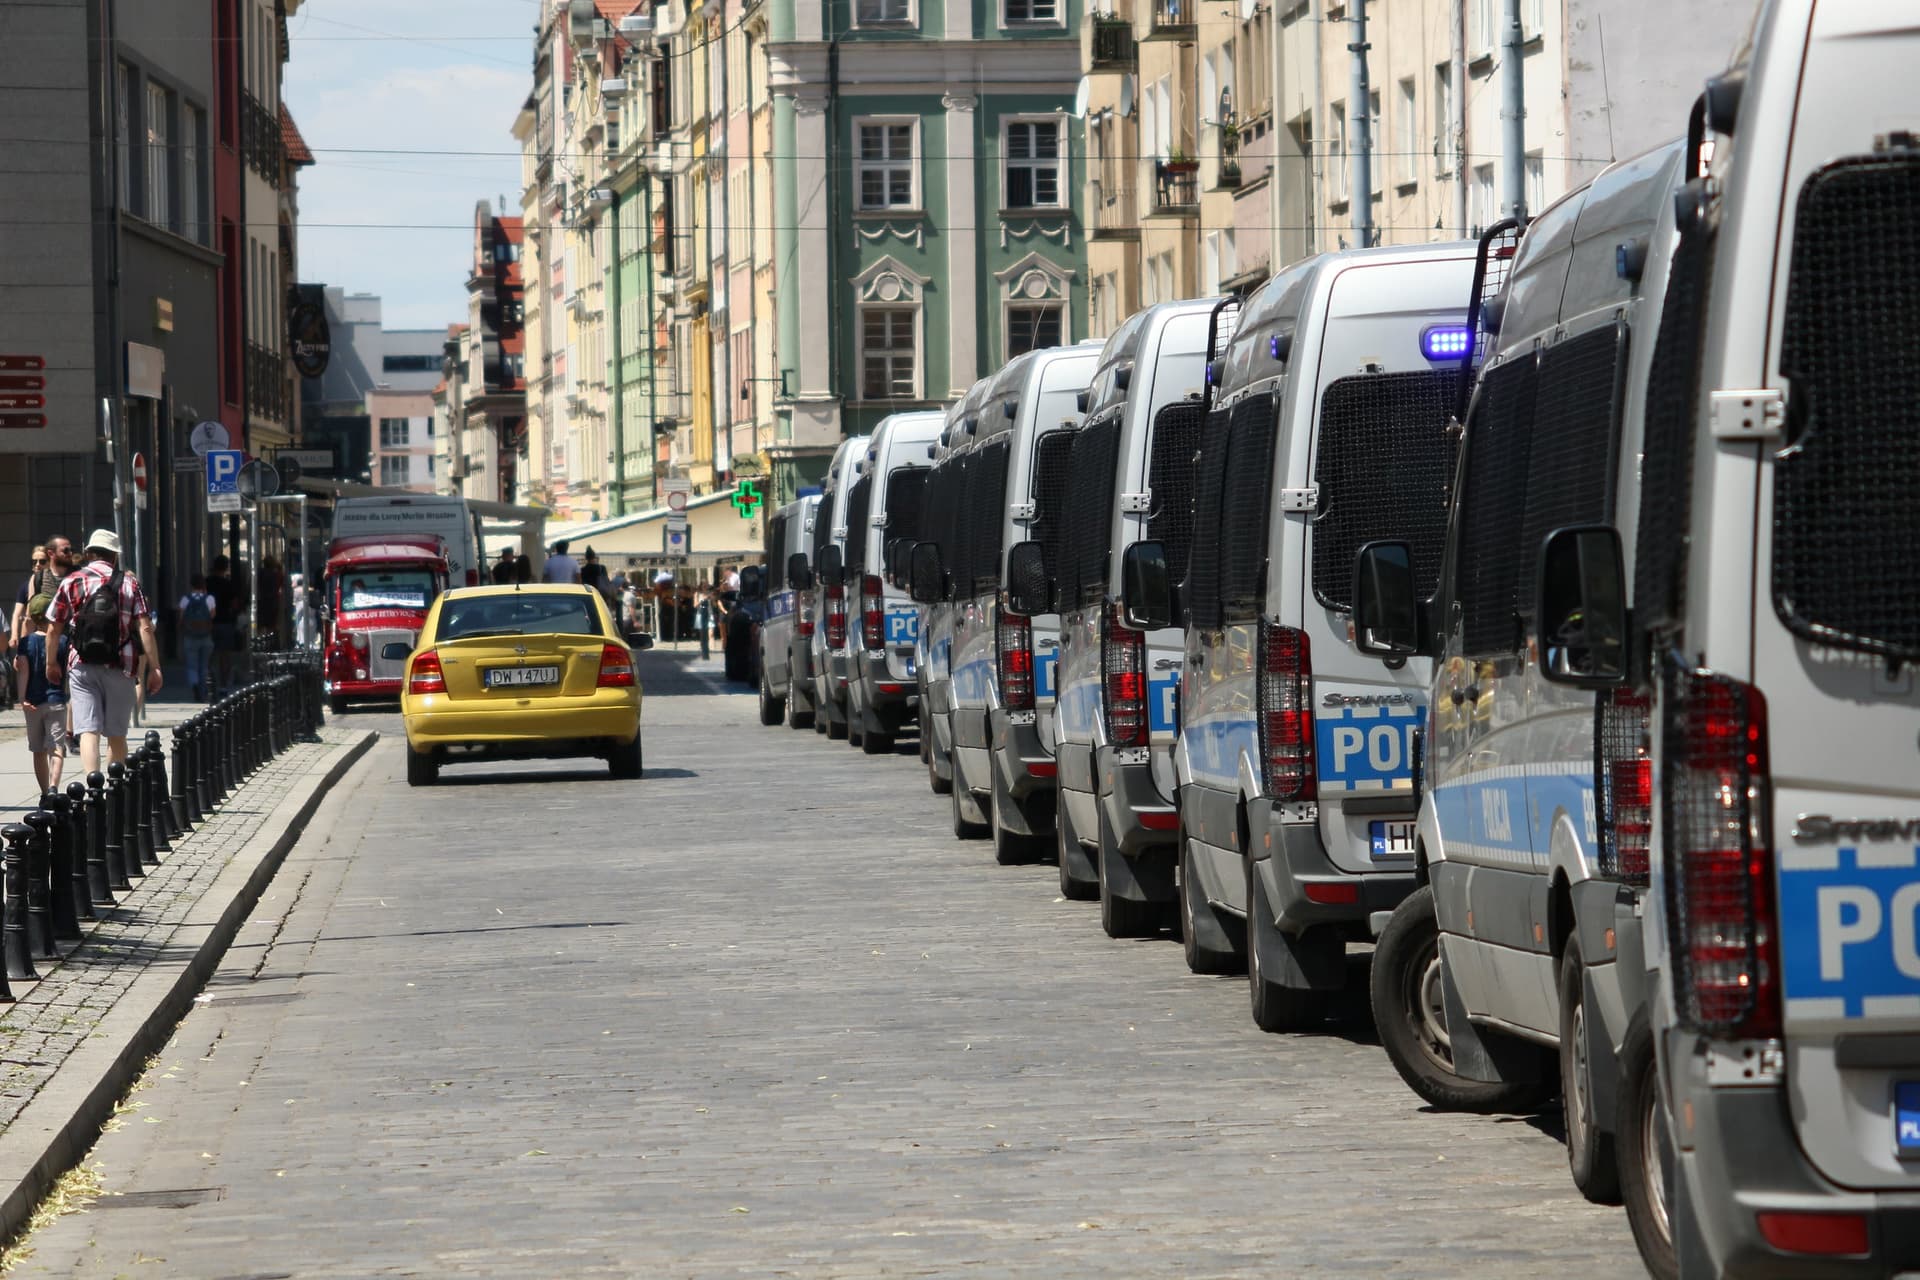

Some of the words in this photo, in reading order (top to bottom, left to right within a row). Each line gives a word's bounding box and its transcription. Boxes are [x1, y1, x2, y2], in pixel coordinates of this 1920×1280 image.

[215, 455, 235, 481] P
[493, 670, 512, 683] DW
[517, 668, 556, 682] 147UJ
